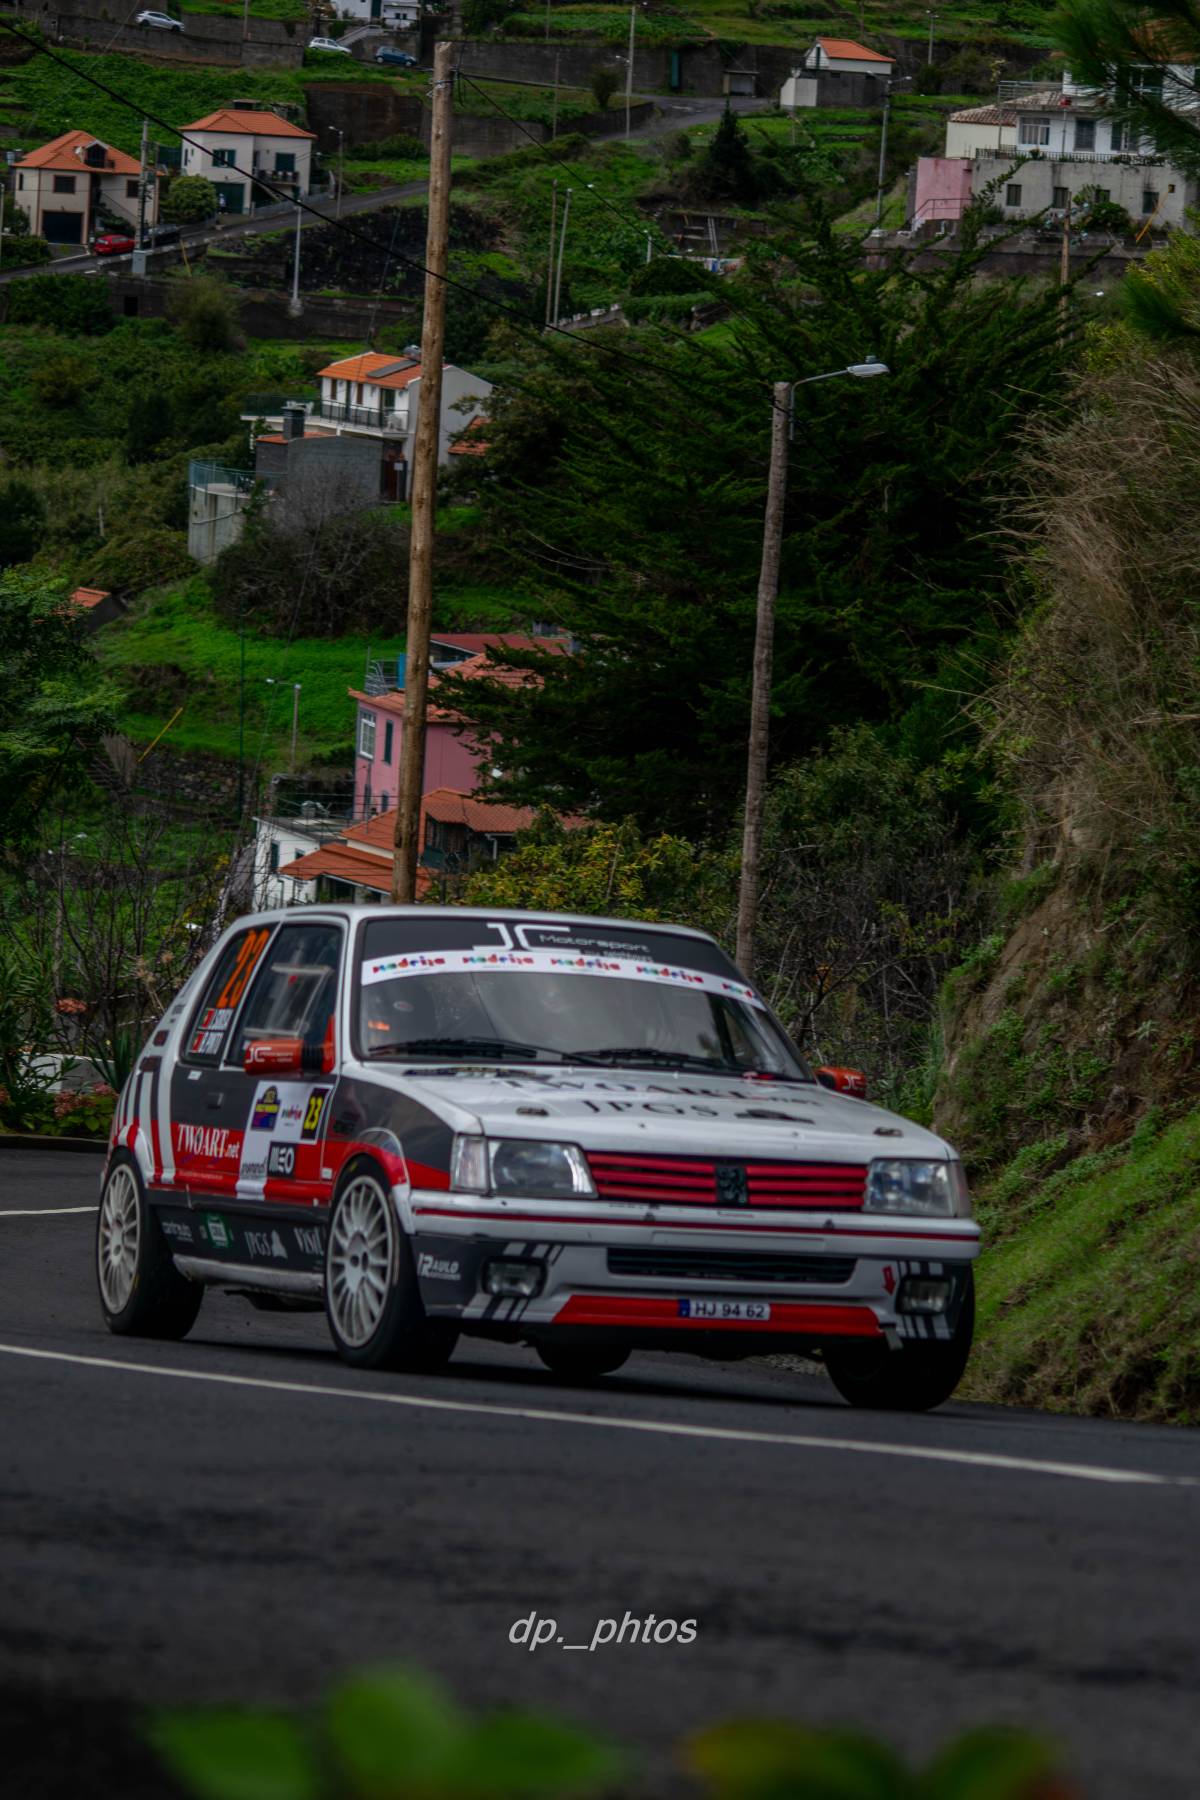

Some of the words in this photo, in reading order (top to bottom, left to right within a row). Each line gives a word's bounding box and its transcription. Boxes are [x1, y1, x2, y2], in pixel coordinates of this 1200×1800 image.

[539, 934, 651, 953] Motorsport
[303, 1095, 324, 1133] 23
[695, 1302, 717, 1316] HJ
[722, 1303, 740, 1317] 94
[746, 1305, 764, 1318] 62
